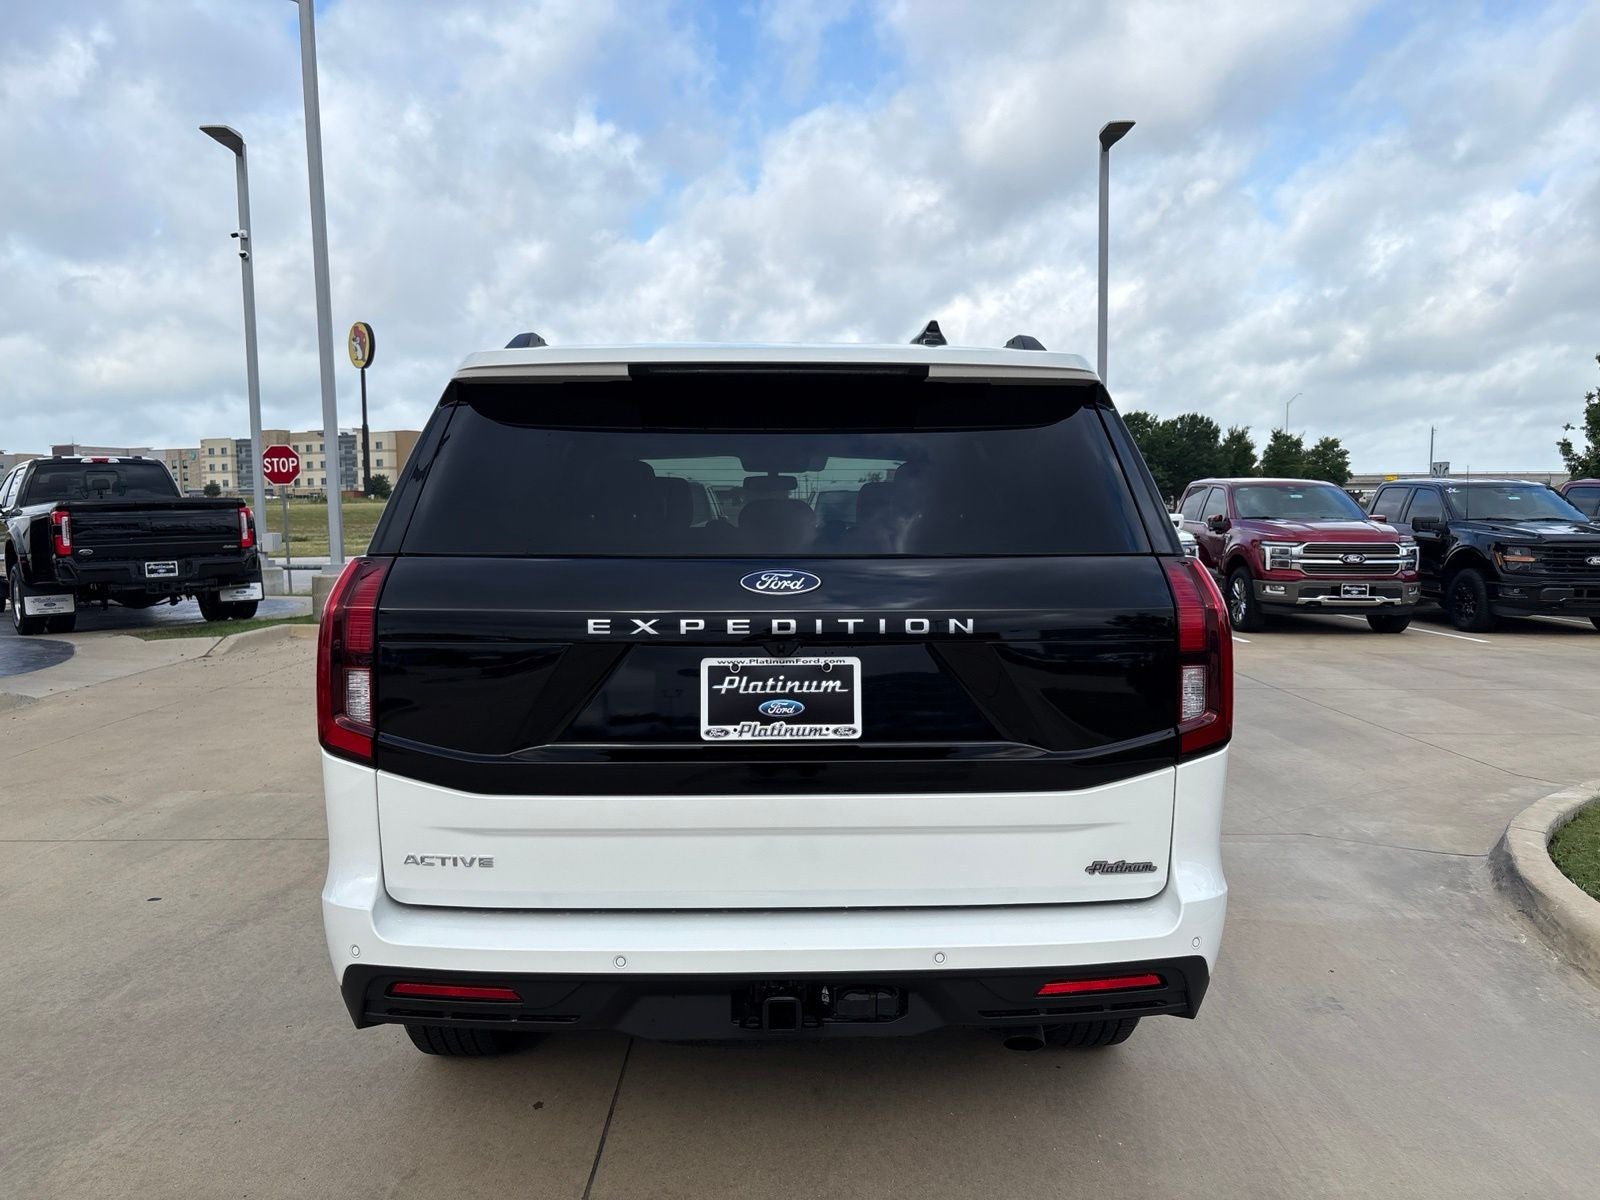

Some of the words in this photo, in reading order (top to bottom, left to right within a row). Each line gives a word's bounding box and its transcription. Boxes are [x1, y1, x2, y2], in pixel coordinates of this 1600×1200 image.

[263, 457, 298, 473] STOP
[756, 573, 805, 590] Ford
[587, 618, 974, 634] EXPEDITION
[717, 657, 846, 666] www.PlatinumFord.com
[712, 675, 849, 695] Platinum
[767, 702, 796, 714] Ford
[738, 722, 830, 738] Platinum
[403, 854, 494, 868] ACTIVE
[1085, 860, 1157, 875] Platinum
